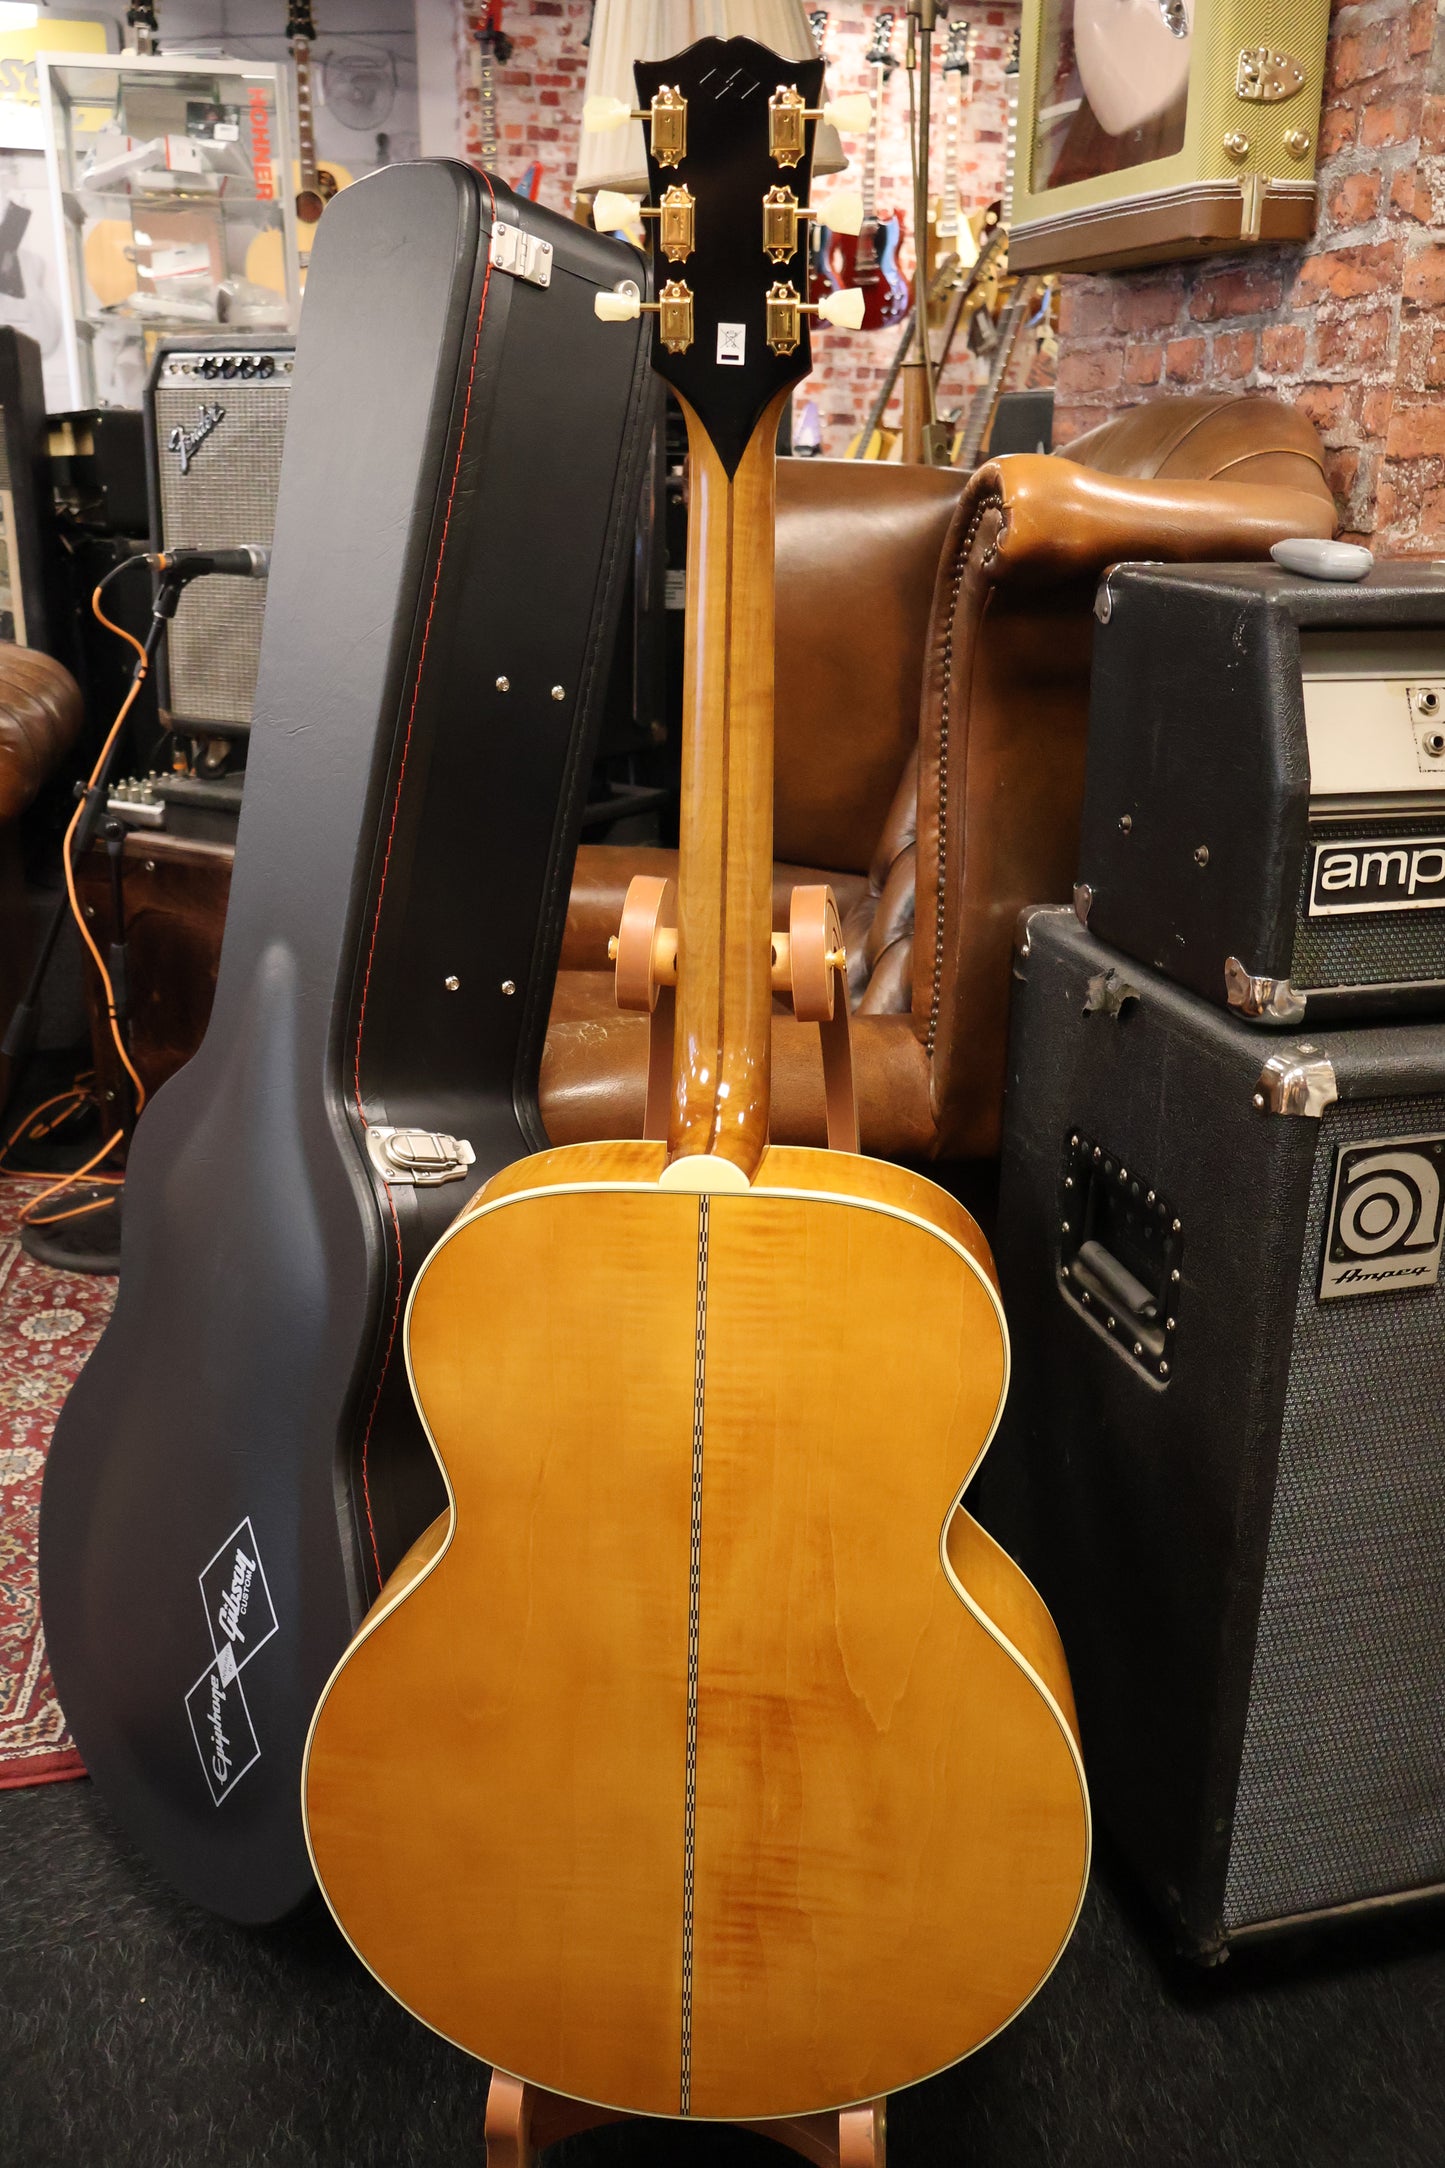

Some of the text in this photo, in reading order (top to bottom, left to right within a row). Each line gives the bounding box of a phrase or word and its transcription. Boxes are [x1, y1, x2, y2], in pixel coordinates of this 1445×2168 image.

[247, 87, 273, 200] HOHNER
[168, 402, 225, 475] Fender
[1332, 1266, 1431, 1284] Ampeg
[219, 1548, 256, 1642] Gibson
[240, 1570, 254, 1615] CUSTOM
[207, 1675, 232, 1785] Epiphone
